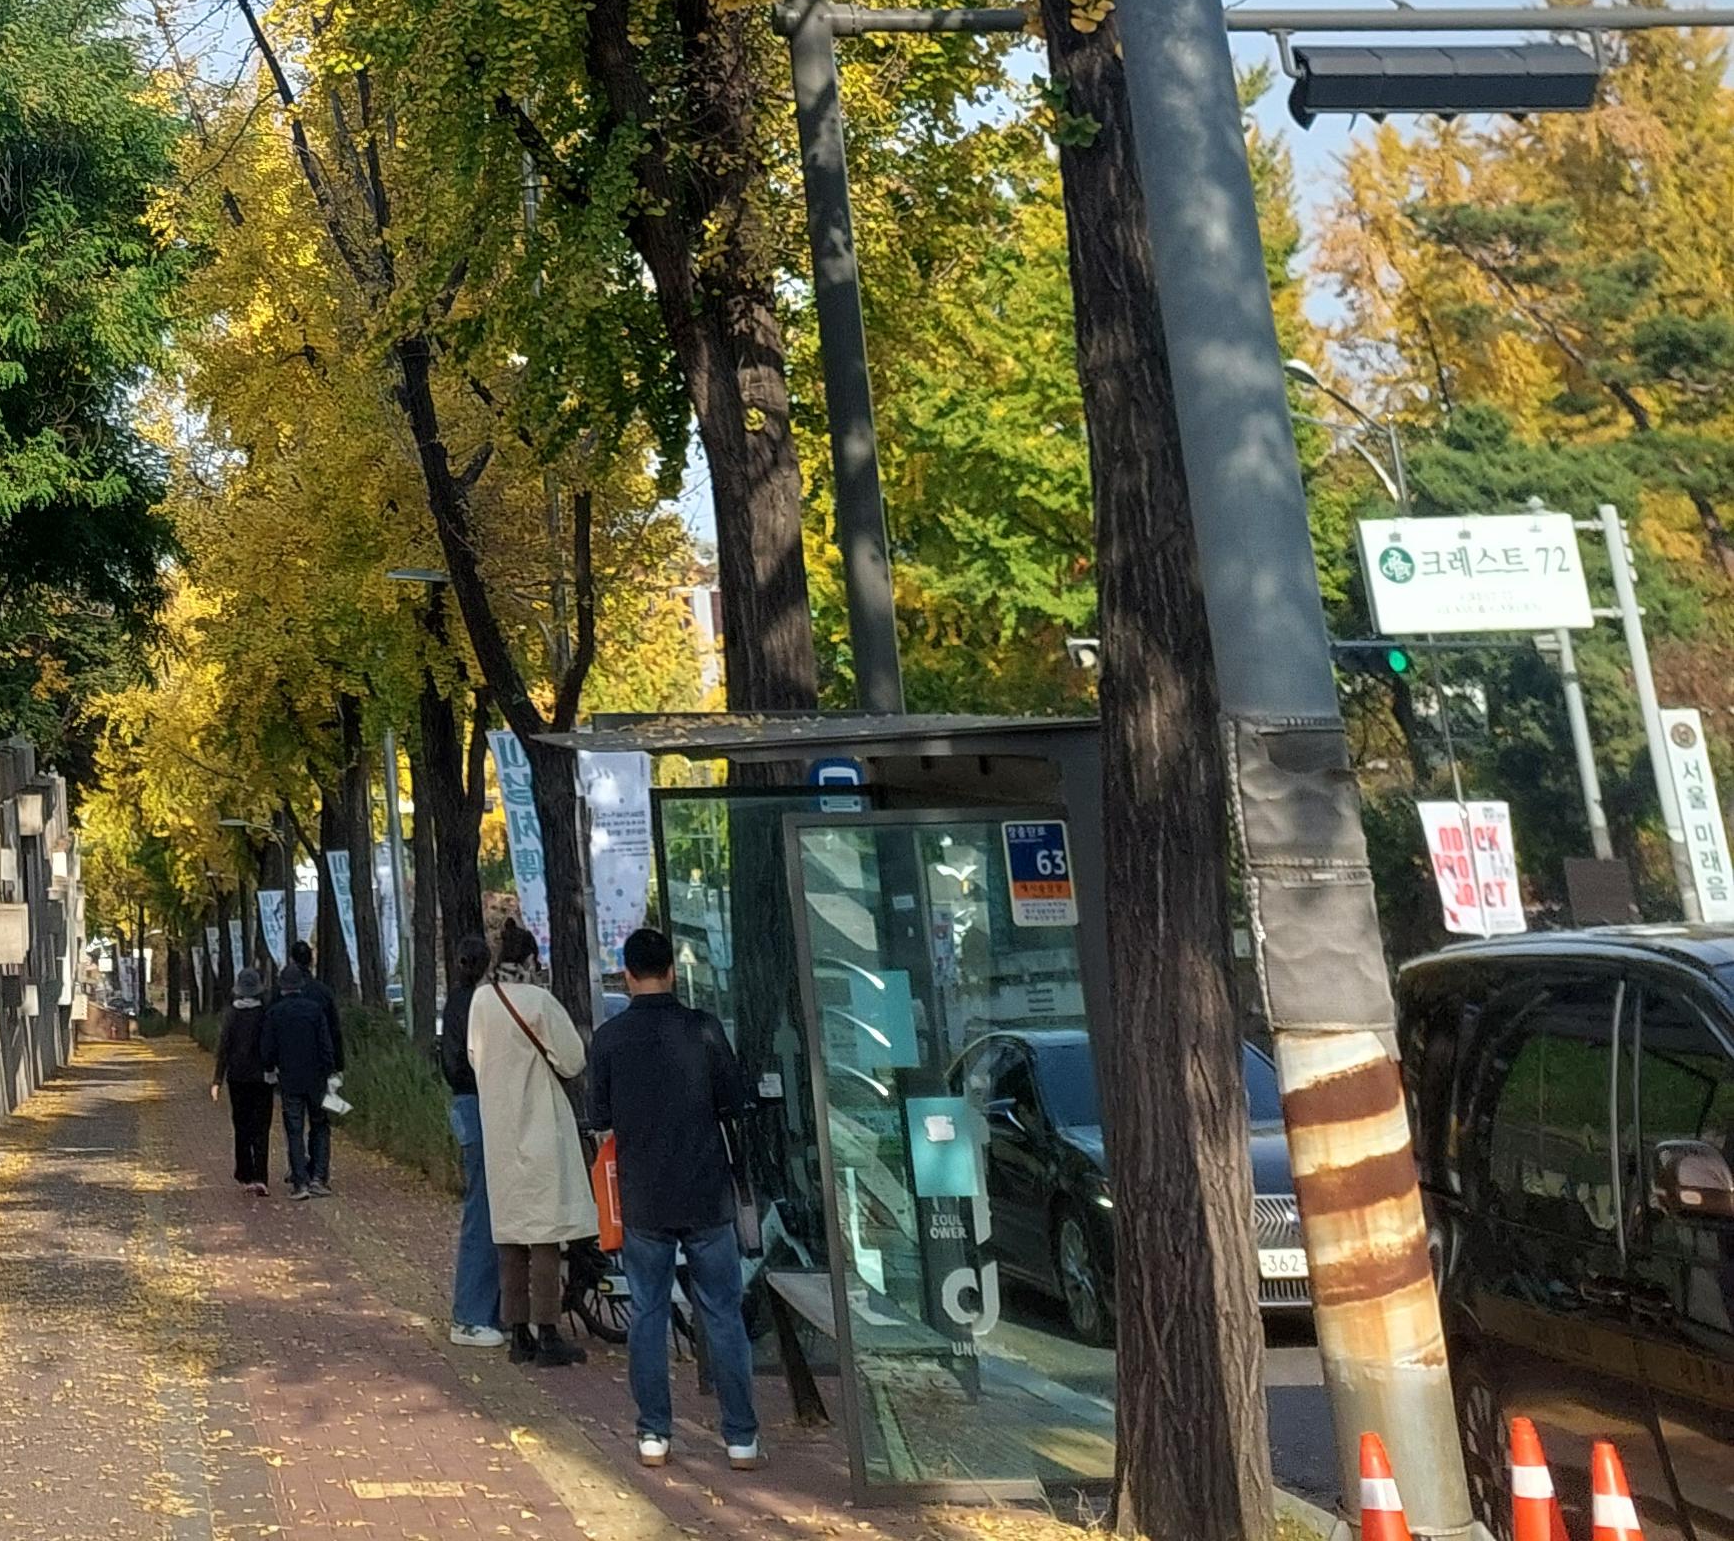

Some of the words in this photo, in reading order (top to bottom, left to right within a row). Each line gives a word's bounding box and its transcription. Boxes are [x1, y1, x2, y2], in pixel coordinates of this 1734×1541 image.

[1421, 546, 1529, 578] 크레스트
[1535, 546, 1570, 575] 72
[1036, 849, 1066, 875] 63
